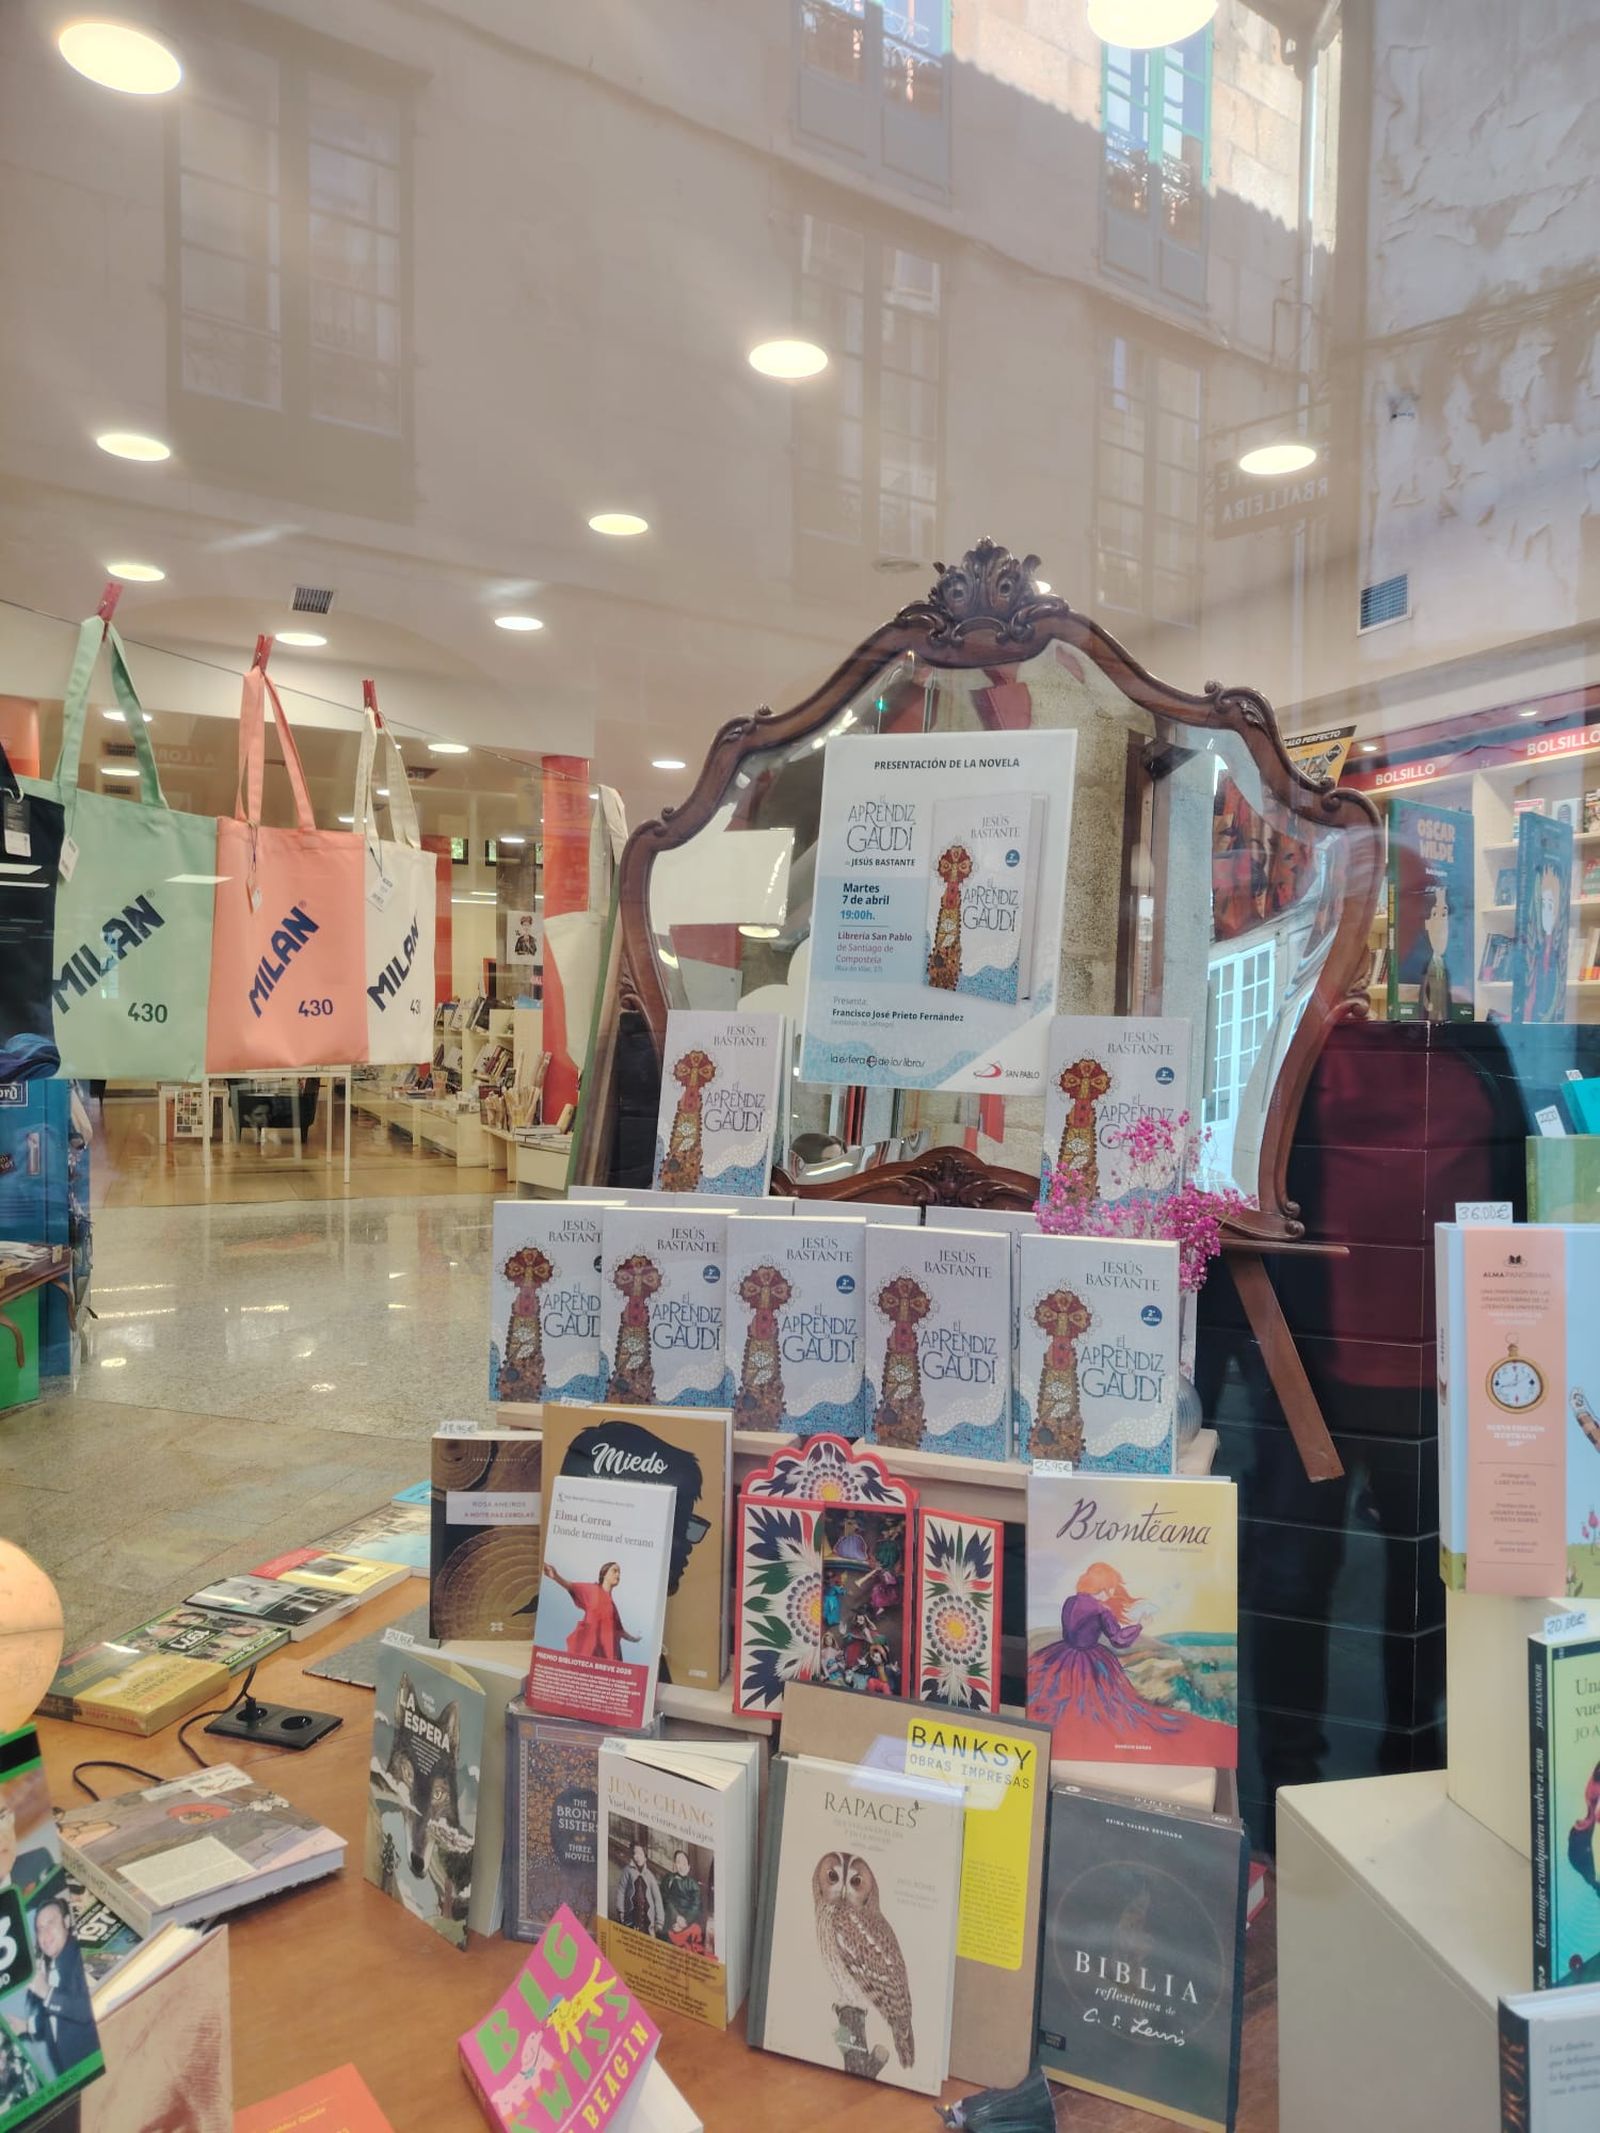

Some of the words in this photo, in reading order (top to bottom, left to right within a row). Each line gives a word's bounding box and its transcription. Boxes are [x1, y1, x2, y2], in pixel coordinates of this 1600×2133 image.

[1302, 730, 1341, 745] PERFECTO
[1527, 731, 1600, 757] BOLSILLO
[874, 757, 947, 770] PRESENTACIÓN
[948, 759, 963, 770] DE
[964, 759, 977, 769] LA
[978, 757, 1020, 769] NOVELA
[1375, 763, 1435, 786] BOLSILLO
[848, 801, 916, 827] APRENDIZ
[847, 822, 916, 853] GAUDÍ
[971, 827, 1021, 839] BASTANTE
[1417, 818, 1456, 842] OSCAR
[851, 857, 873, 867] JESÚS
[874, 858, 916, 867] BASTANTE
[842, 895, 848, 904] 7
[850, 895, 863, 904] de
[865, 895, 890, 905] abril
[843, 883, 880, 893] Martes
[964, 885, 1019, 907] APRENDIZ
[840, 910, 876, 921] 19:00h.
[963, 905, 1019, 932] GAUDÍ
[848, 943, 882, 953] Santiago
[871, 932, 887, 940] San
[889, 932, 912, 941] Pablo
[52, 894, 166, 1014] MILAN
[249, 906, 320, 1018] MILAN
[366, 912, 419, 1012] MILAN
[127, 1002, 168, 1024] 430
[298, 998, 334, 1018] 430
[408, 998, 421, 1016] 43
[832, 1008, 871, 1018] Francisco
[872, 1009, 890, 1019] José
[892, 1011, 918, 1019] Prieto
[714, 1035, 767, 1048] BASTANTE
[726, 1023, 756, 1036] JESÚS
[1123, 1030, 1160, 1043] JESÚS
[1107, 1043, 1174, 1056] BASTANTE
[1005, 1070, 1019, 1078] SAN
[1019, 1071, 1040, 1079] PABLO
[704, 1089, 766, 1112] APRENDIZ
[703, 1108, 766, 1133] GAUDÍ
[1099, 1102, 1174, 1126] APRENDIZ
[562, 1217, 597, 1232] JESÚS
[671, 1225, 705, 1240] JESÚS
[549, 1231, 602, 1244] BASTANT
[657, 1240, 720, 1254] BASTANTE
[802, 1235, 838, 1249] JESÚS
[786, 1249, 853, 1263] BASTANTE
[939, 1248, 976, 1264] JESÚS
[1102, 1260, 1143, 1276] JESÚS
[924, 1261, 992, 1279] BASTANTE
[1086, 1273, 1160, 1292] BASTANTE
[543, 1290, 601, 1316] APREND
[652, 1301, 722, 1328] APRENDIZ
[543, 1312, 601, 1338] GAUD
[652, 1321, 723, 1351] GAUDÍ
[781, 1313, 858, 1339] APRENDIZ
[782, 1335, 858, 1364] GAUDÍ
[920, 1328, 998, 1355] APRENDIZ
[921, 1351, 999, 1384] GAUDÍ
[1080, 1344, 1166, 1372] APRENDIZ
[1081, 1367, 1167, 1403] GAUDÍ
[591, 1442, 668, 1475] Miedo
[554, 1509, 578, 1522] Elma
[580, 1513, 612, 1527] Correa
[1056, 1497, 1212, 1546] Brontëana
[553, 1524, 580, 1538] Donde
[581, 1529, 614, 1543] termina
[615, 1533, 623, 1544] el
[624, 1537, 655, 1549] verano
[535, 1651, 558, 1662] PREMIO
[558, 1656, 594, 1668] BIBLIOTECA
[594, 1662, 616, 1673] BREVE
[400, 1688, 416, 1712] LA
[1535, 1663, 1544, 1716] ALEXANDER
[404, 1710, 450, 1753] ESPERA
[1574, 1726, 1590, 1743] JO
[911, 1725, 1032, 1771] BANKSY
[910, 1753, 952, 1772] OBRAS
[961, 1763, 1030, 1790] IMPRESAS
[1535, 1747, 1545, 1774] casa
[556, 1804, 598, 1821] BRONT
[573, 1798, 588, 1808] THE
[608, 1775, 649, 1803] JUNG
[653, 1792, 714, 1827] CHANG
[824, 1791, 918, 1829] RAPACES
[1533, 1785, 1545, 1821] vuelve
[564, 1851, 596, 1863] NOVELS
[568, 1843, 592, 1854] THREE
[1534, 1824, 1549, 1885] cualquiera
[1536, 1886, 1549, 1921] mujer
[77, 1904, 117, 1942] 197
[1535, 1924, 1547, 1949] Una
[1074, 1949, 1198, 2005] BIBLIA
[475, 1921, 578, 2076] BIG
[1095, 1985, 1161, 2013] reflexiones
[1165, 2006, 1176, 2016] de
[1083, 2008, 1101, 2024] C.
[1130, 2018, 1185, 2047] Lewis
[581, 2020, 649, 2130] BEAGIN
